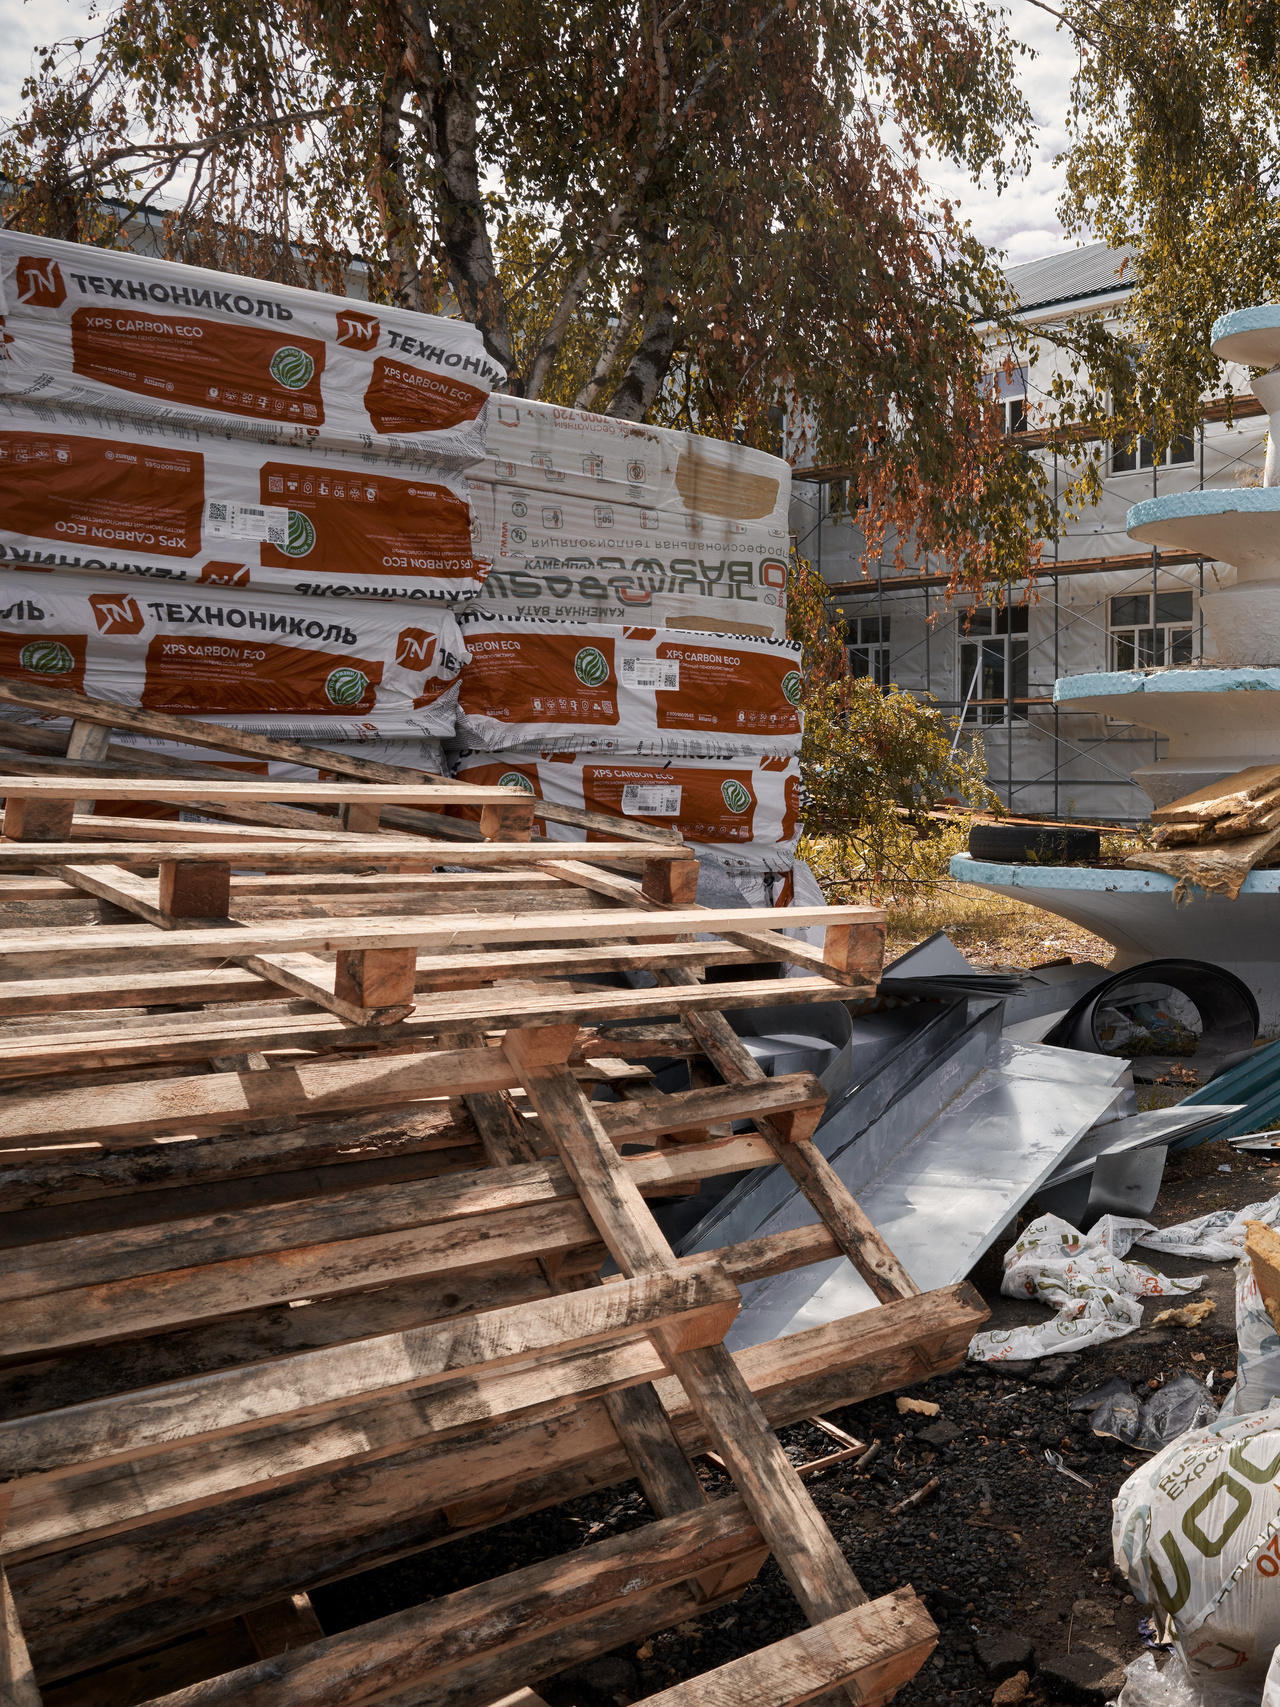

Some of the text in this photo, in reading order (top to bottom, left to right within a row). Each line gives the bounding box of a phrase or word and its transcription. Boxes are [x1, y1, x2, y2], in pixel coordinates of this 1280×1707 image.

[70, 272, 294, 322] ТЕХНОНИКОЛЬ
[85, 316, 204, 338] XPS CARBON ECO
[383, 365, 401, 380] XPS
[402, 372, 449, 395] CARBON
[449, 387, 472, 402] ECO
[54, 520, 187, 549] XPS CARBON ECO
[382, 556, 408, 567] ECO
[410, 557, 460, 570] CARBON
[516, 605, 626, 618] КАМЕННАЯ ВАТА
[147, 602, 358, 646] ТЕХНОНИКОЛЬ
[161, 643, 187, 656] XPS
[187, 643, 240, 659] CARBON
[467, 640, 521, 653] RBON ECO
[666, 649, 741, 666] XPS CARBON ECO
[592, 769, 613, 778] XPS
[614, 769, 654, 780] CARBON
